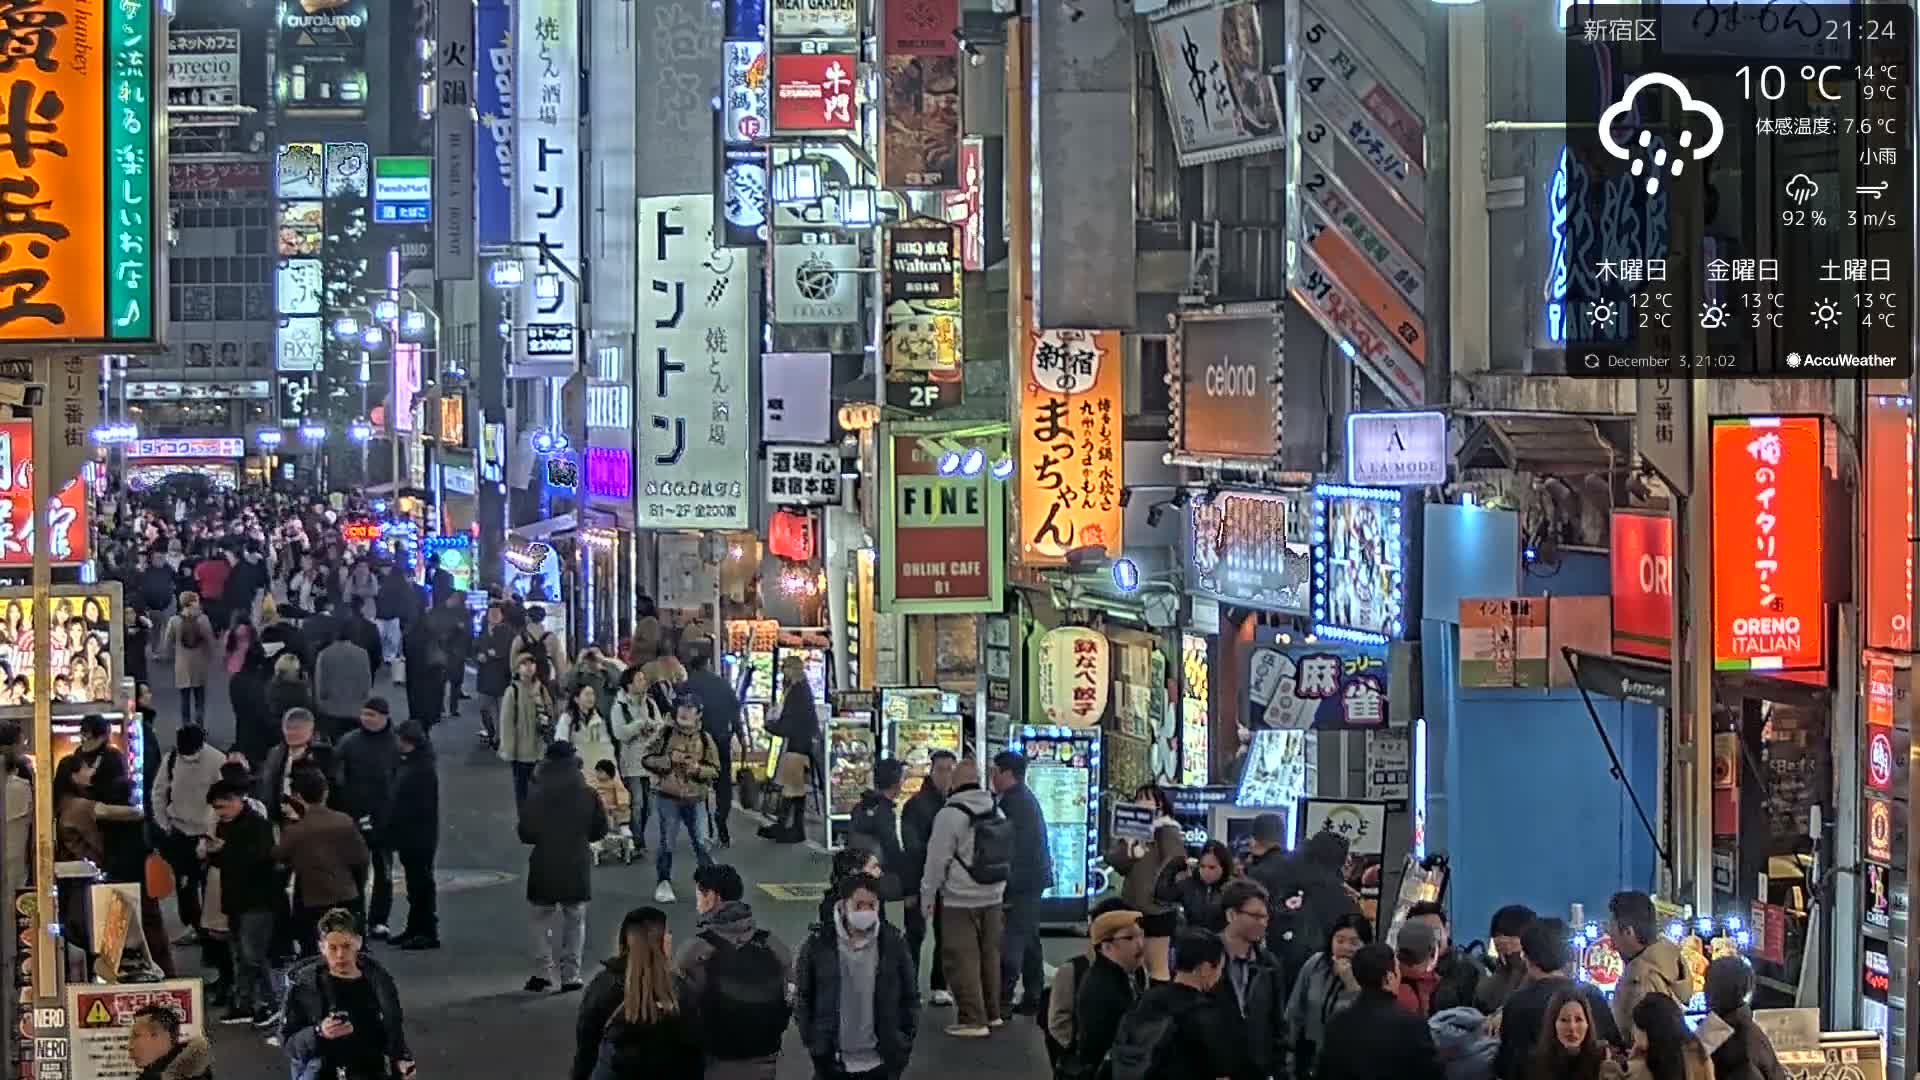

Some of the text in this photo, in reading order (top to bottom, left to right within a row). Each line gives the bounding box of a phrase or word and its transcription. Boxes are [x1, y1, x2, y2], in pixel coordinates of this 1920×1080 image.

[1306, 24, 1327, 43] 5
[442, 41, 468, 105] 火鍋
[822, 60, 852, 123] 牛門
[1306, 76, 1325, 93] 4
[1307, 124, 1326, 143] 3
[1306, 173, 1325, 193] 2
[652, 210, 686, 466] トントン
[1206, 354, 1256, 397] celona
[909, 386, 940, 407] 2F
[1385, 423, 1407, 452] A
[771, 451, 837, 474] 酒場心
[1033, 396, 1076, 547] まっちゃん
[771, 475, 837, 496] 新宿本店
[903, 487, 980, 516] FINE
[1746, 432, 1781, 607] 俺のイタリアン
[902, 561, 982, 577] ONLINE CAFE
[1732, 616, 1801, 636] ORENO
[1732, 635, 1801, 655] ITALIAN
[33, 1009, 64, 1027] NERO
[36, 1039, 67, 1059] NERO
